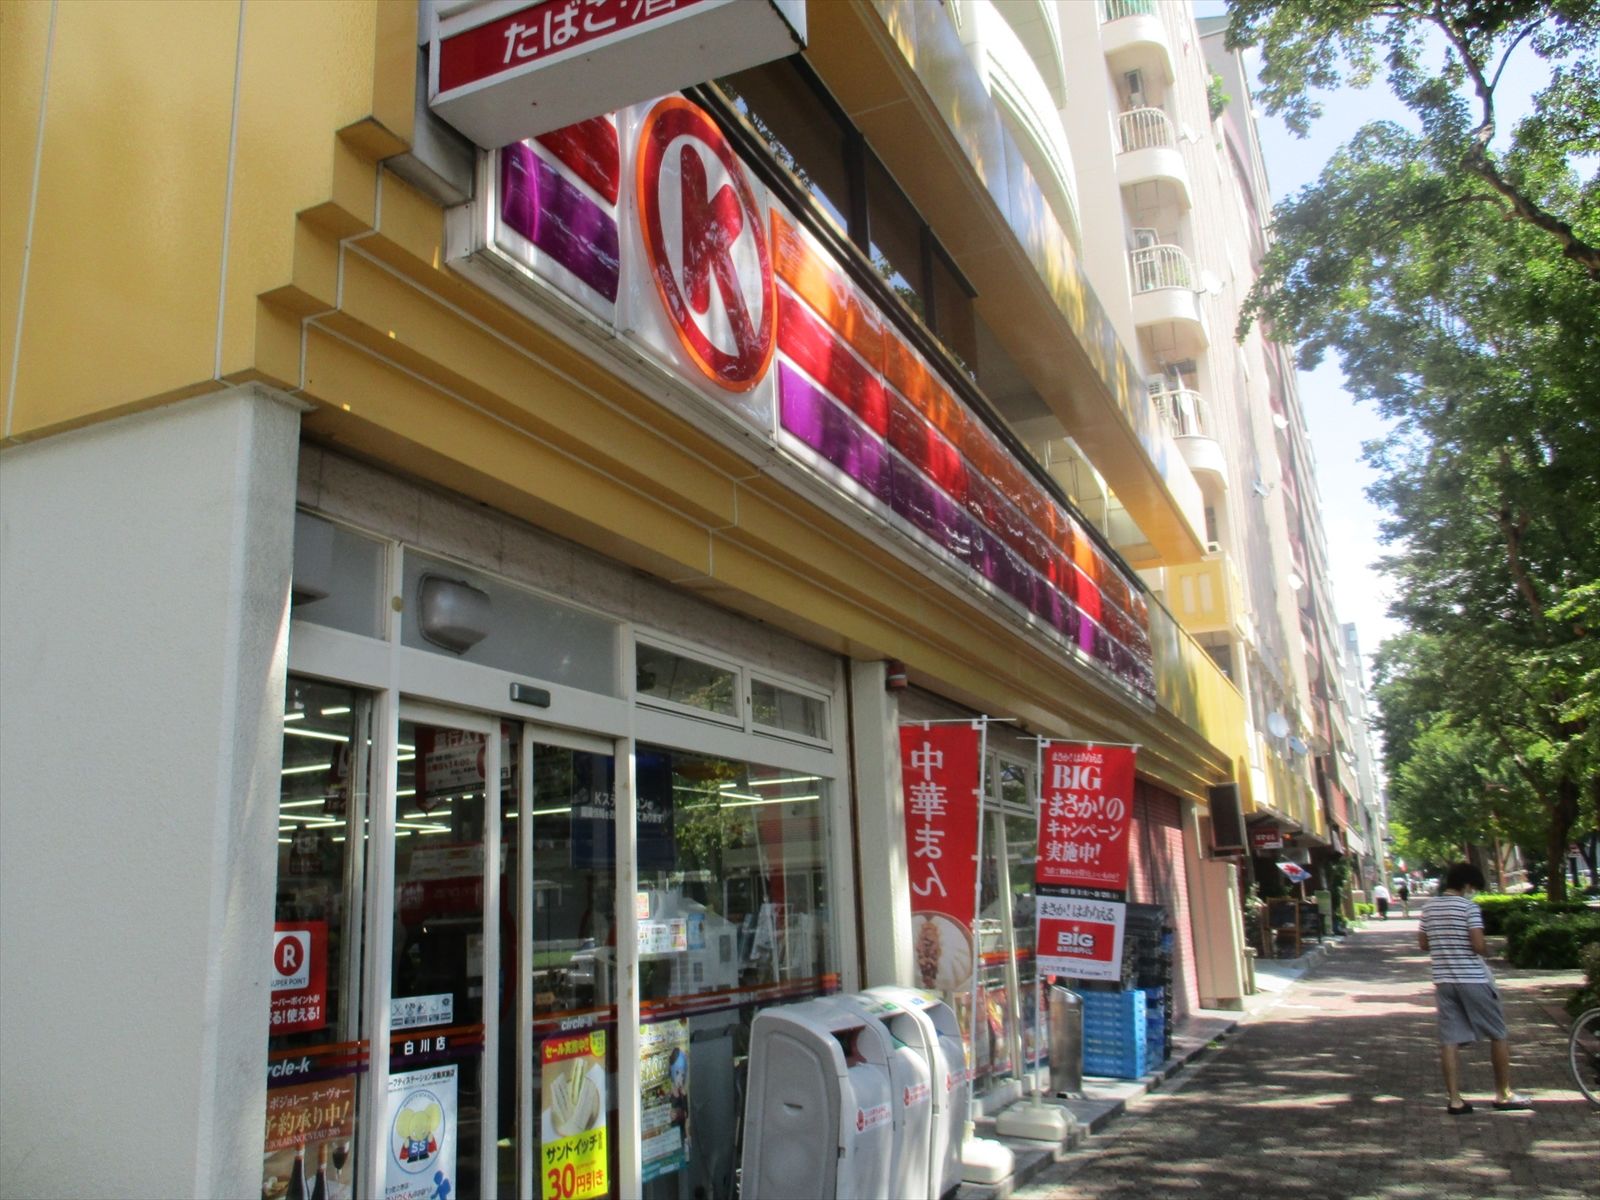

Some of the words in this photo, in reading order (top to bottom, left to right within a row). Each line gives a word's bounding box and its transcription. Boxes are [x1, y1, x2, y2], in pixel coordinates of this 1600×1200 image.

[1051, 764, 1102, 791] BIG
[1048, 791, 1125, 821] まさか!の
[909, 741, 948, 897] 中華まん
[1046, 818, 1122, 842] キャンペーン
[1045, 840, 1102, 865] 実施中!
[282, 944, 297, 968] R
[289, 977, 306, 985] POINT
[271, 994, 320, 1006] ーパーポイントが
[404, 1036, 446, 1056] 白川店
[546, 1133, 598, 1165] サンドイッチ
